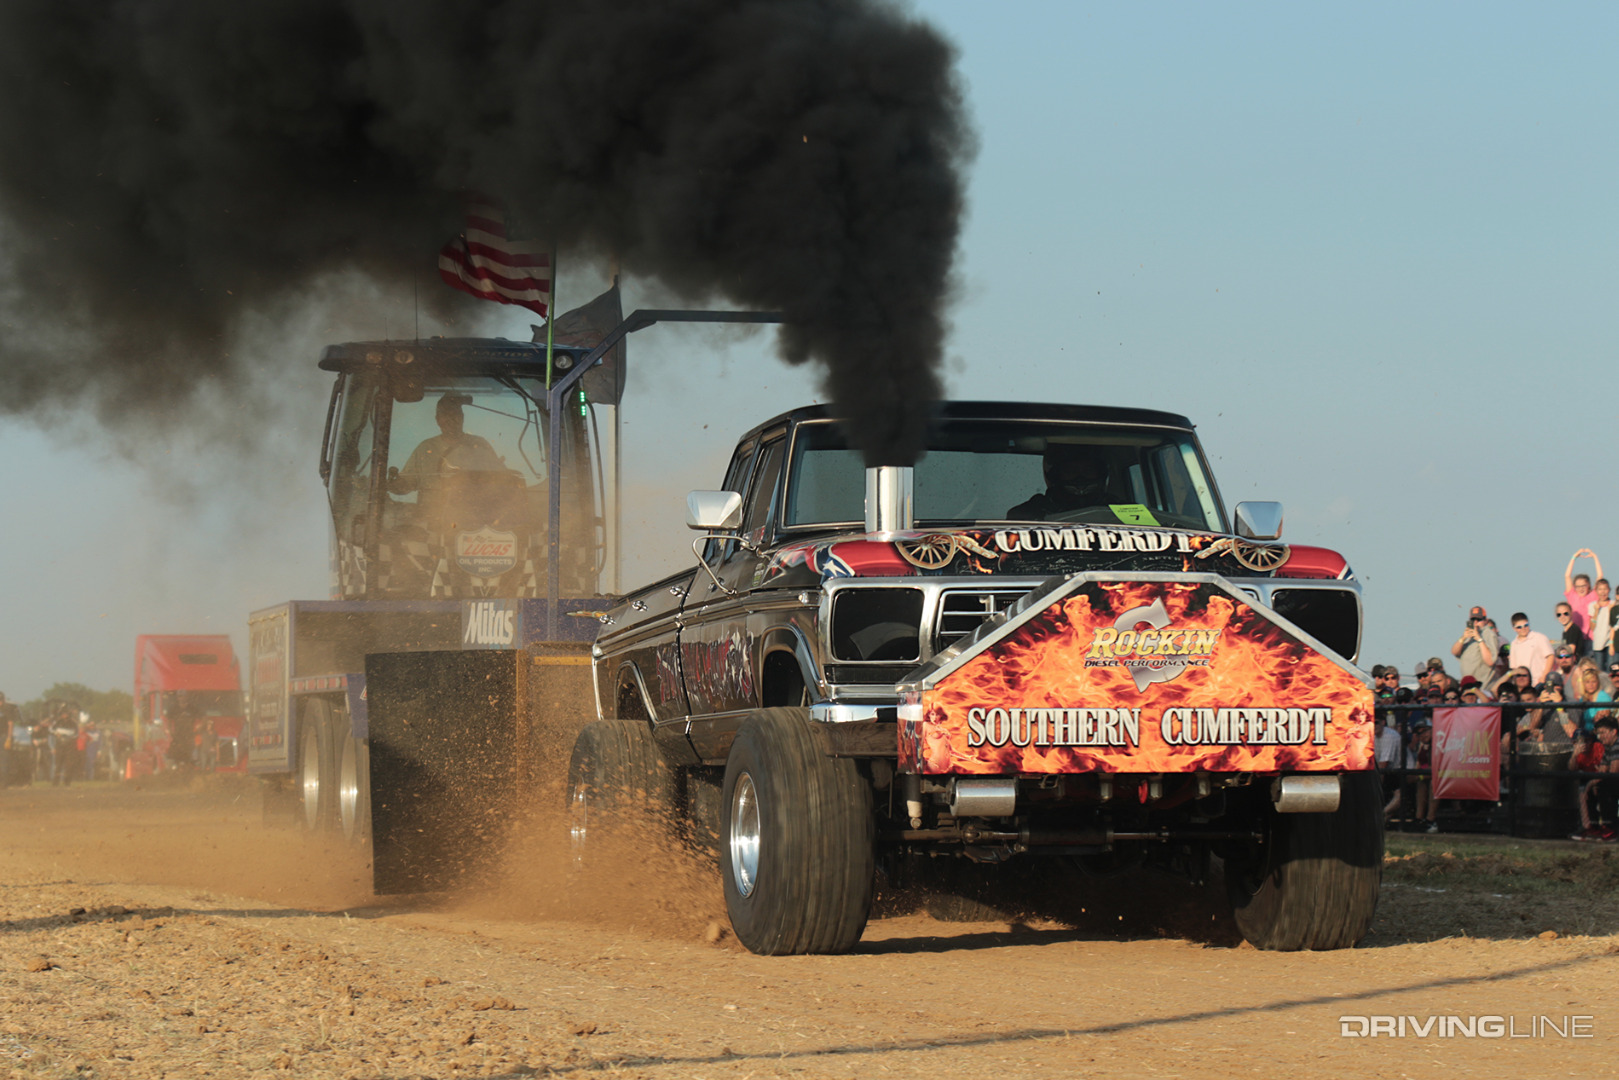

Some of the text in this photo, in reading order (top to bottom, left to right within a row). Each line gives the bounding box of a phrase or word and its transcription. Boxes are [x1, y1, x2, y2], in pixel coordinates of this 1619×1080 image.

[464, 543, 513, 556] LUCAS
[995, 528, 1195, 552] CUMFERDT
[464, 602, 514, 645] Mitas
[1085, 627, 1222, 659] ROCKIN
[1084, 659, 1209, 668] DIESEL PERFORMANCE
[967, 707, 1332, 747] SOUTHERN CUMFERDT
